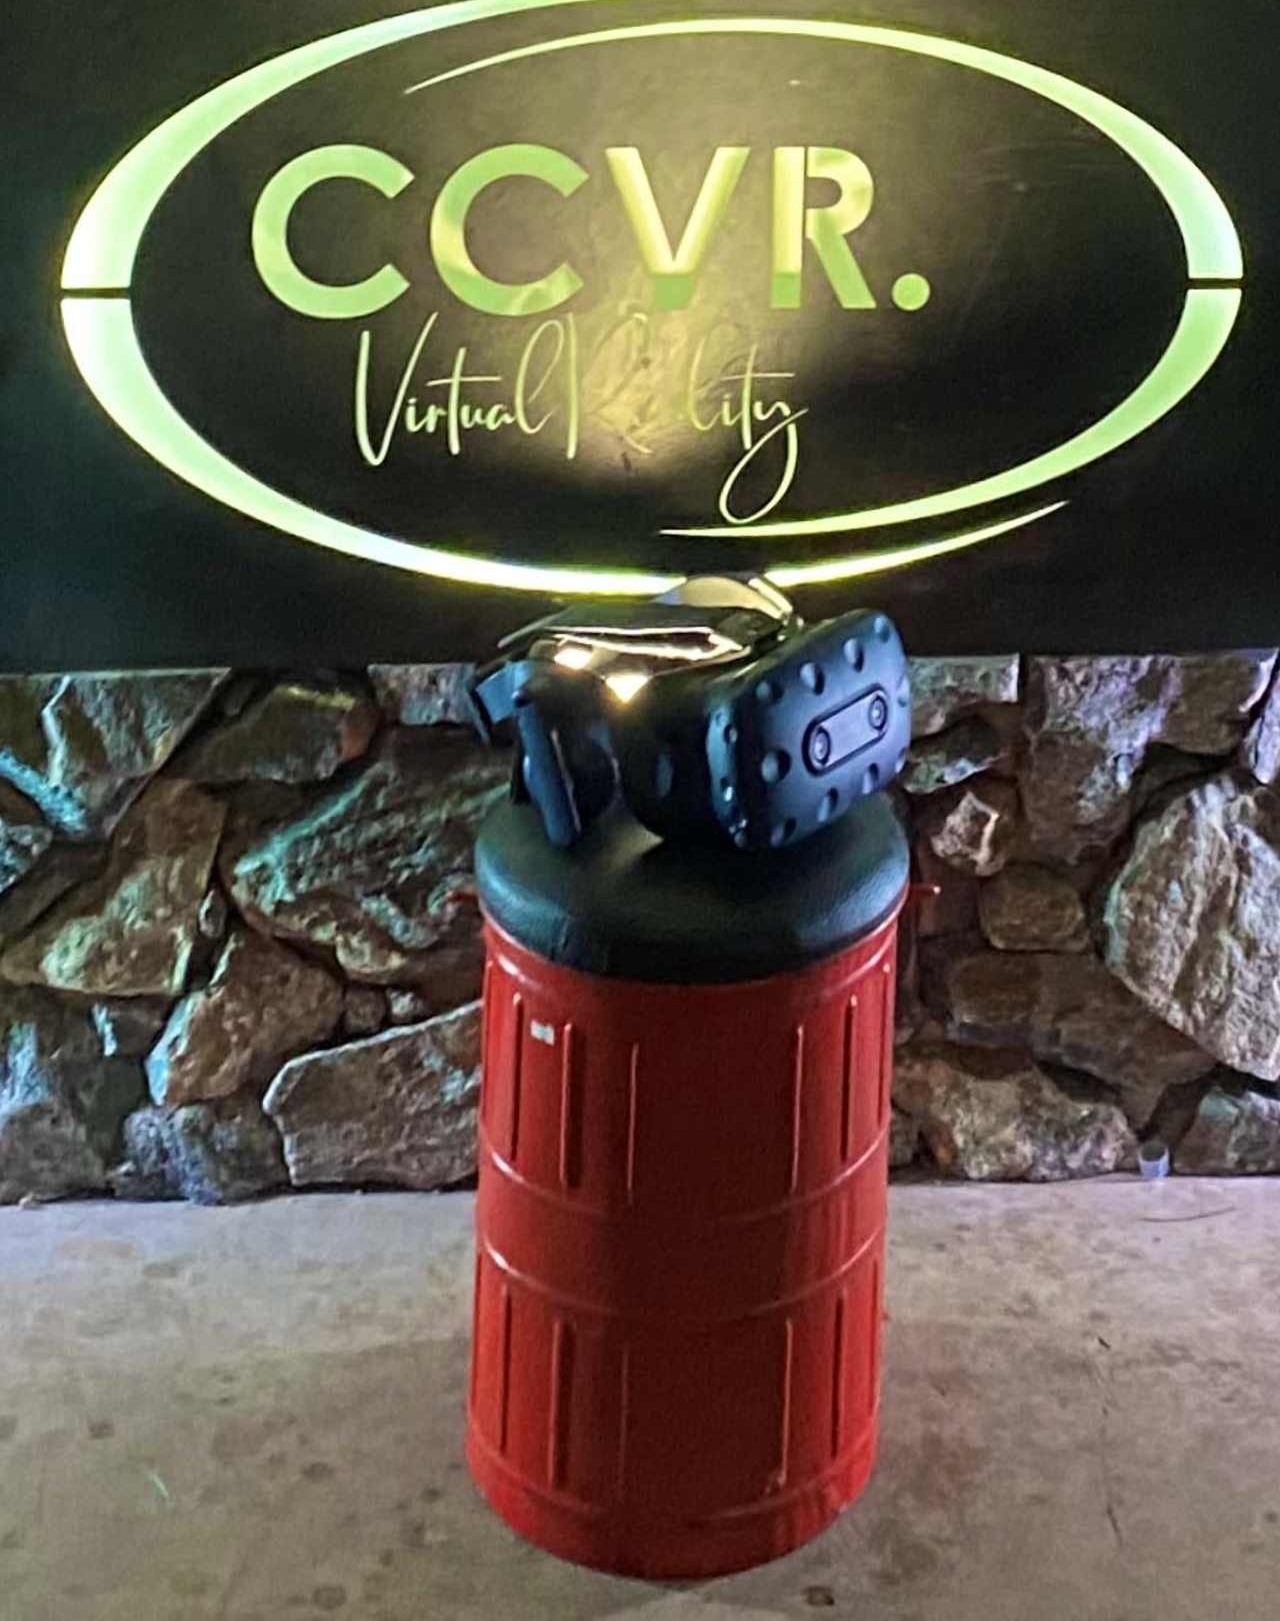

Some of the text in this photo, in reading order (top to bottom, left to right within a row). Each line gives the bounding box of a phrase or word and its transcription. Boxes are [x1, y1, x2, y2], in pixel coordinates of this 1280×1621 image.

[251, 143, 930, 319] CCVR.
[356, 312, 808, 524] Virtual Rlity
